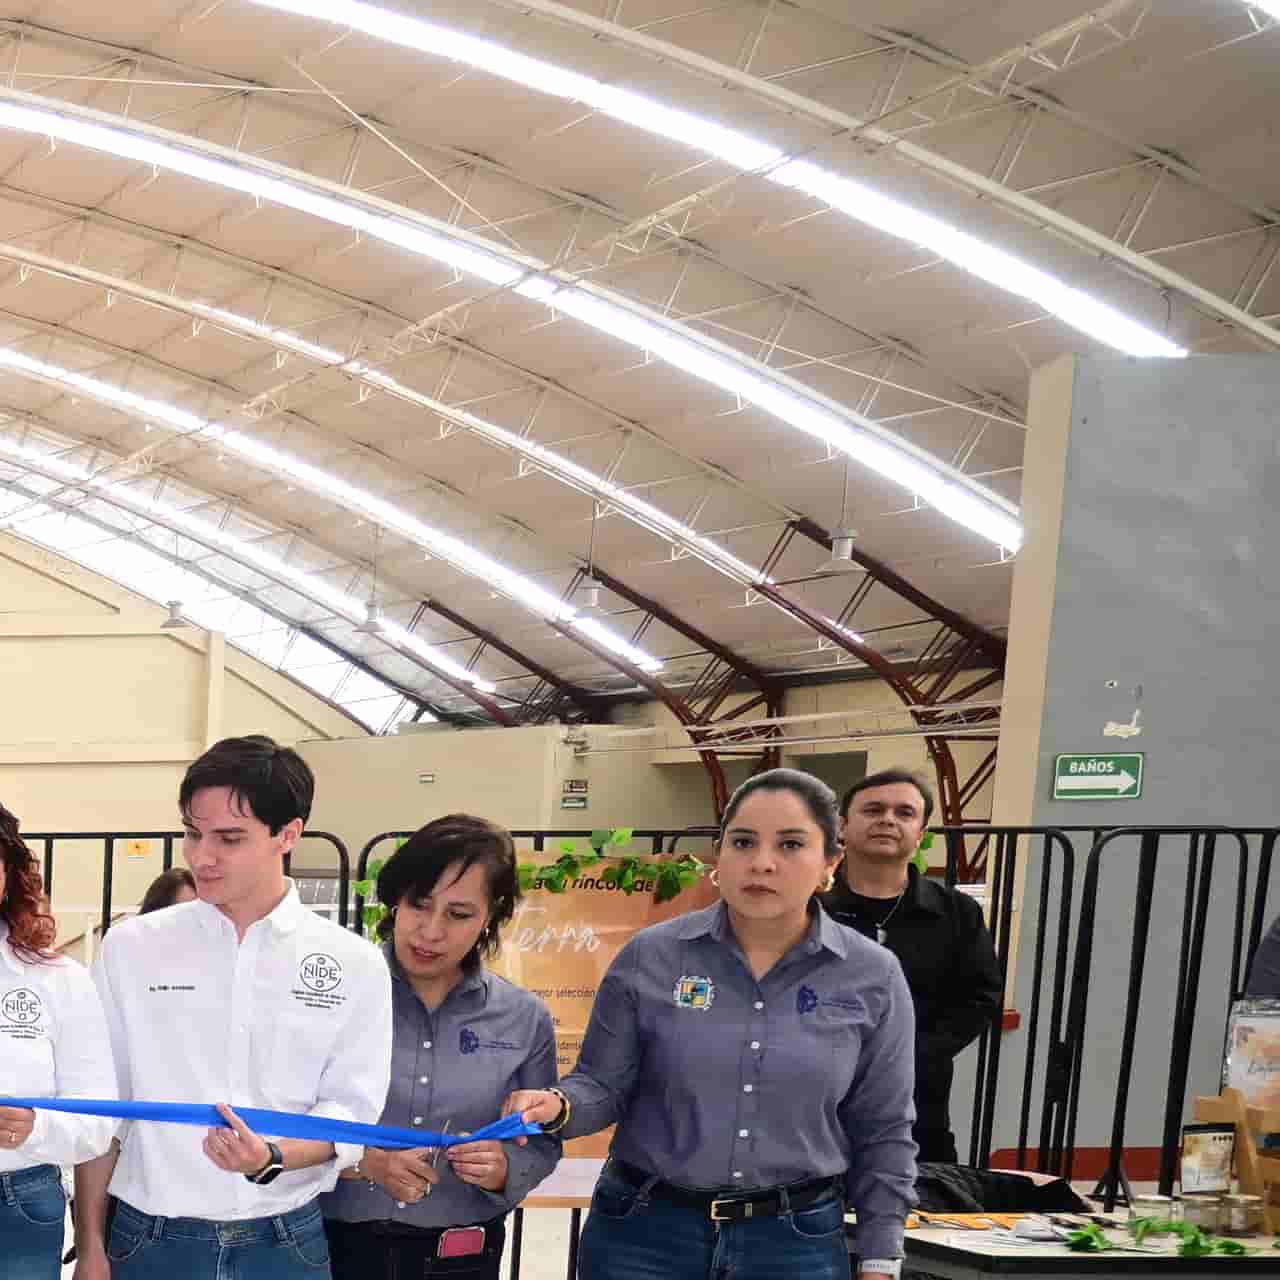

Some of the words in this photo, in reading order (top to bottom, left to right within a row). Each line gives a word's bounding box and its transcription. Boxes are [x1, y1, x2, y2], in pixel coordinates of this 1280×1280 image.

[1069, 758, 1115, 773] BAÑOS
[304, 962, 338, 980] NIDE
[5, 999, 38, 1016] NIDE
